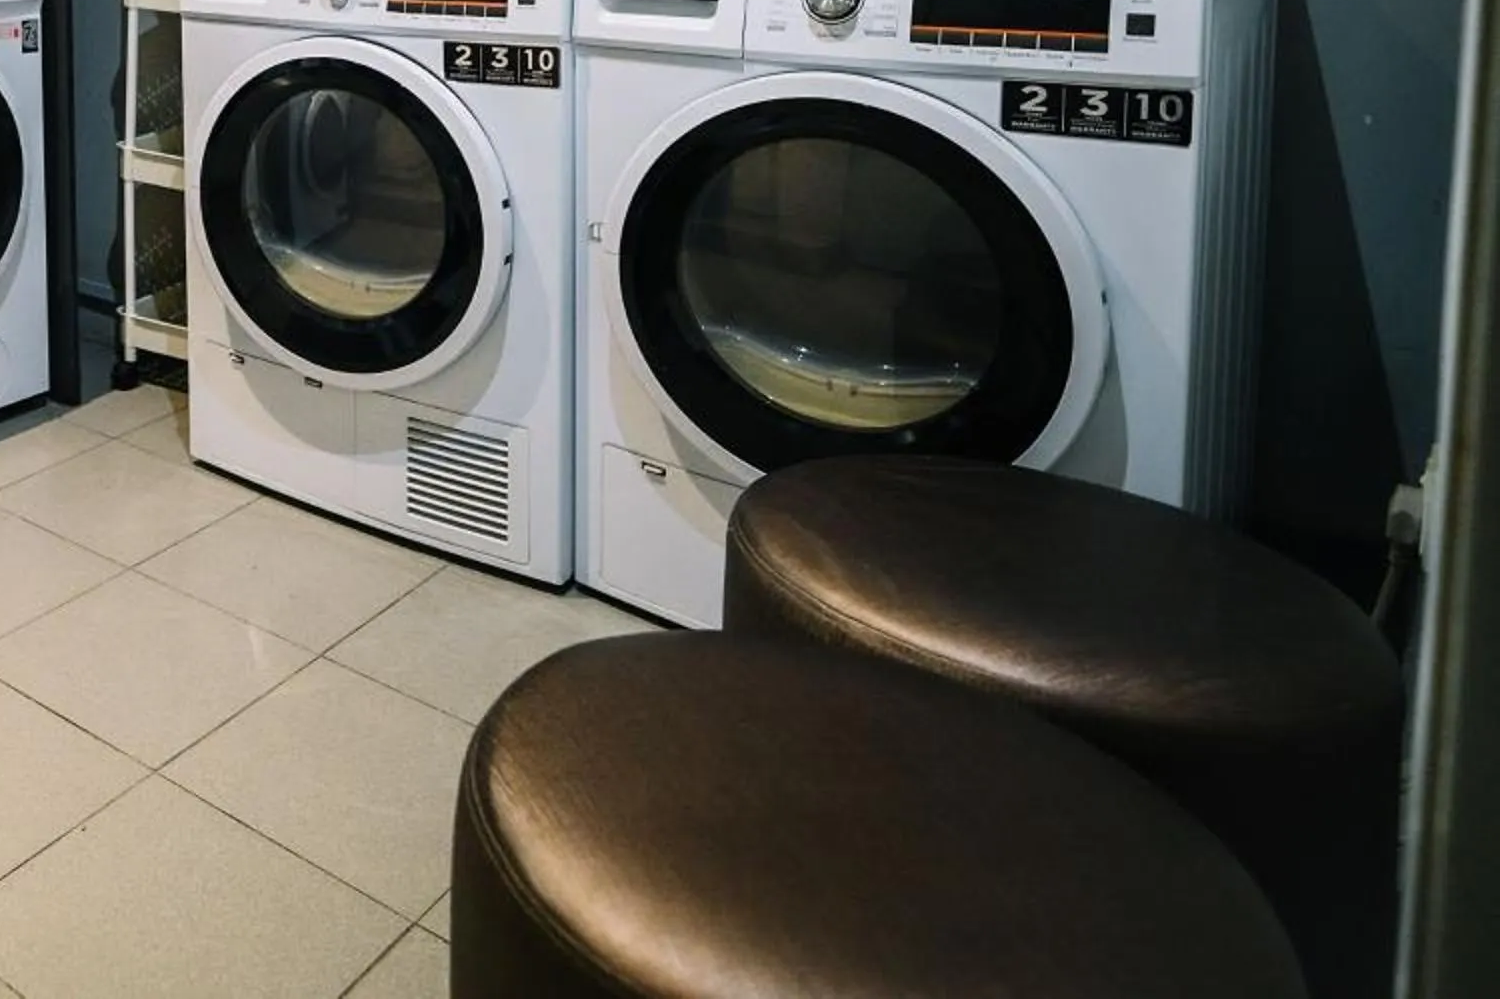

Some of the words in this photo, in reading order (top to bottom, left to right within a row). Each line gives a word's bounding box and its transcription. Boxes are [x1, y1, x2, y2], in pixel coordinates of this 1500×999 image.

[455, 44, 472, 66] 2
[491, 46, 509, 68] 3
[523, 48, 555, 71] 10
[1019, 85, 1048, 112] 2
[1080, 88, 1109, 117] 3
[1135, 92, 1184, 122] 10
